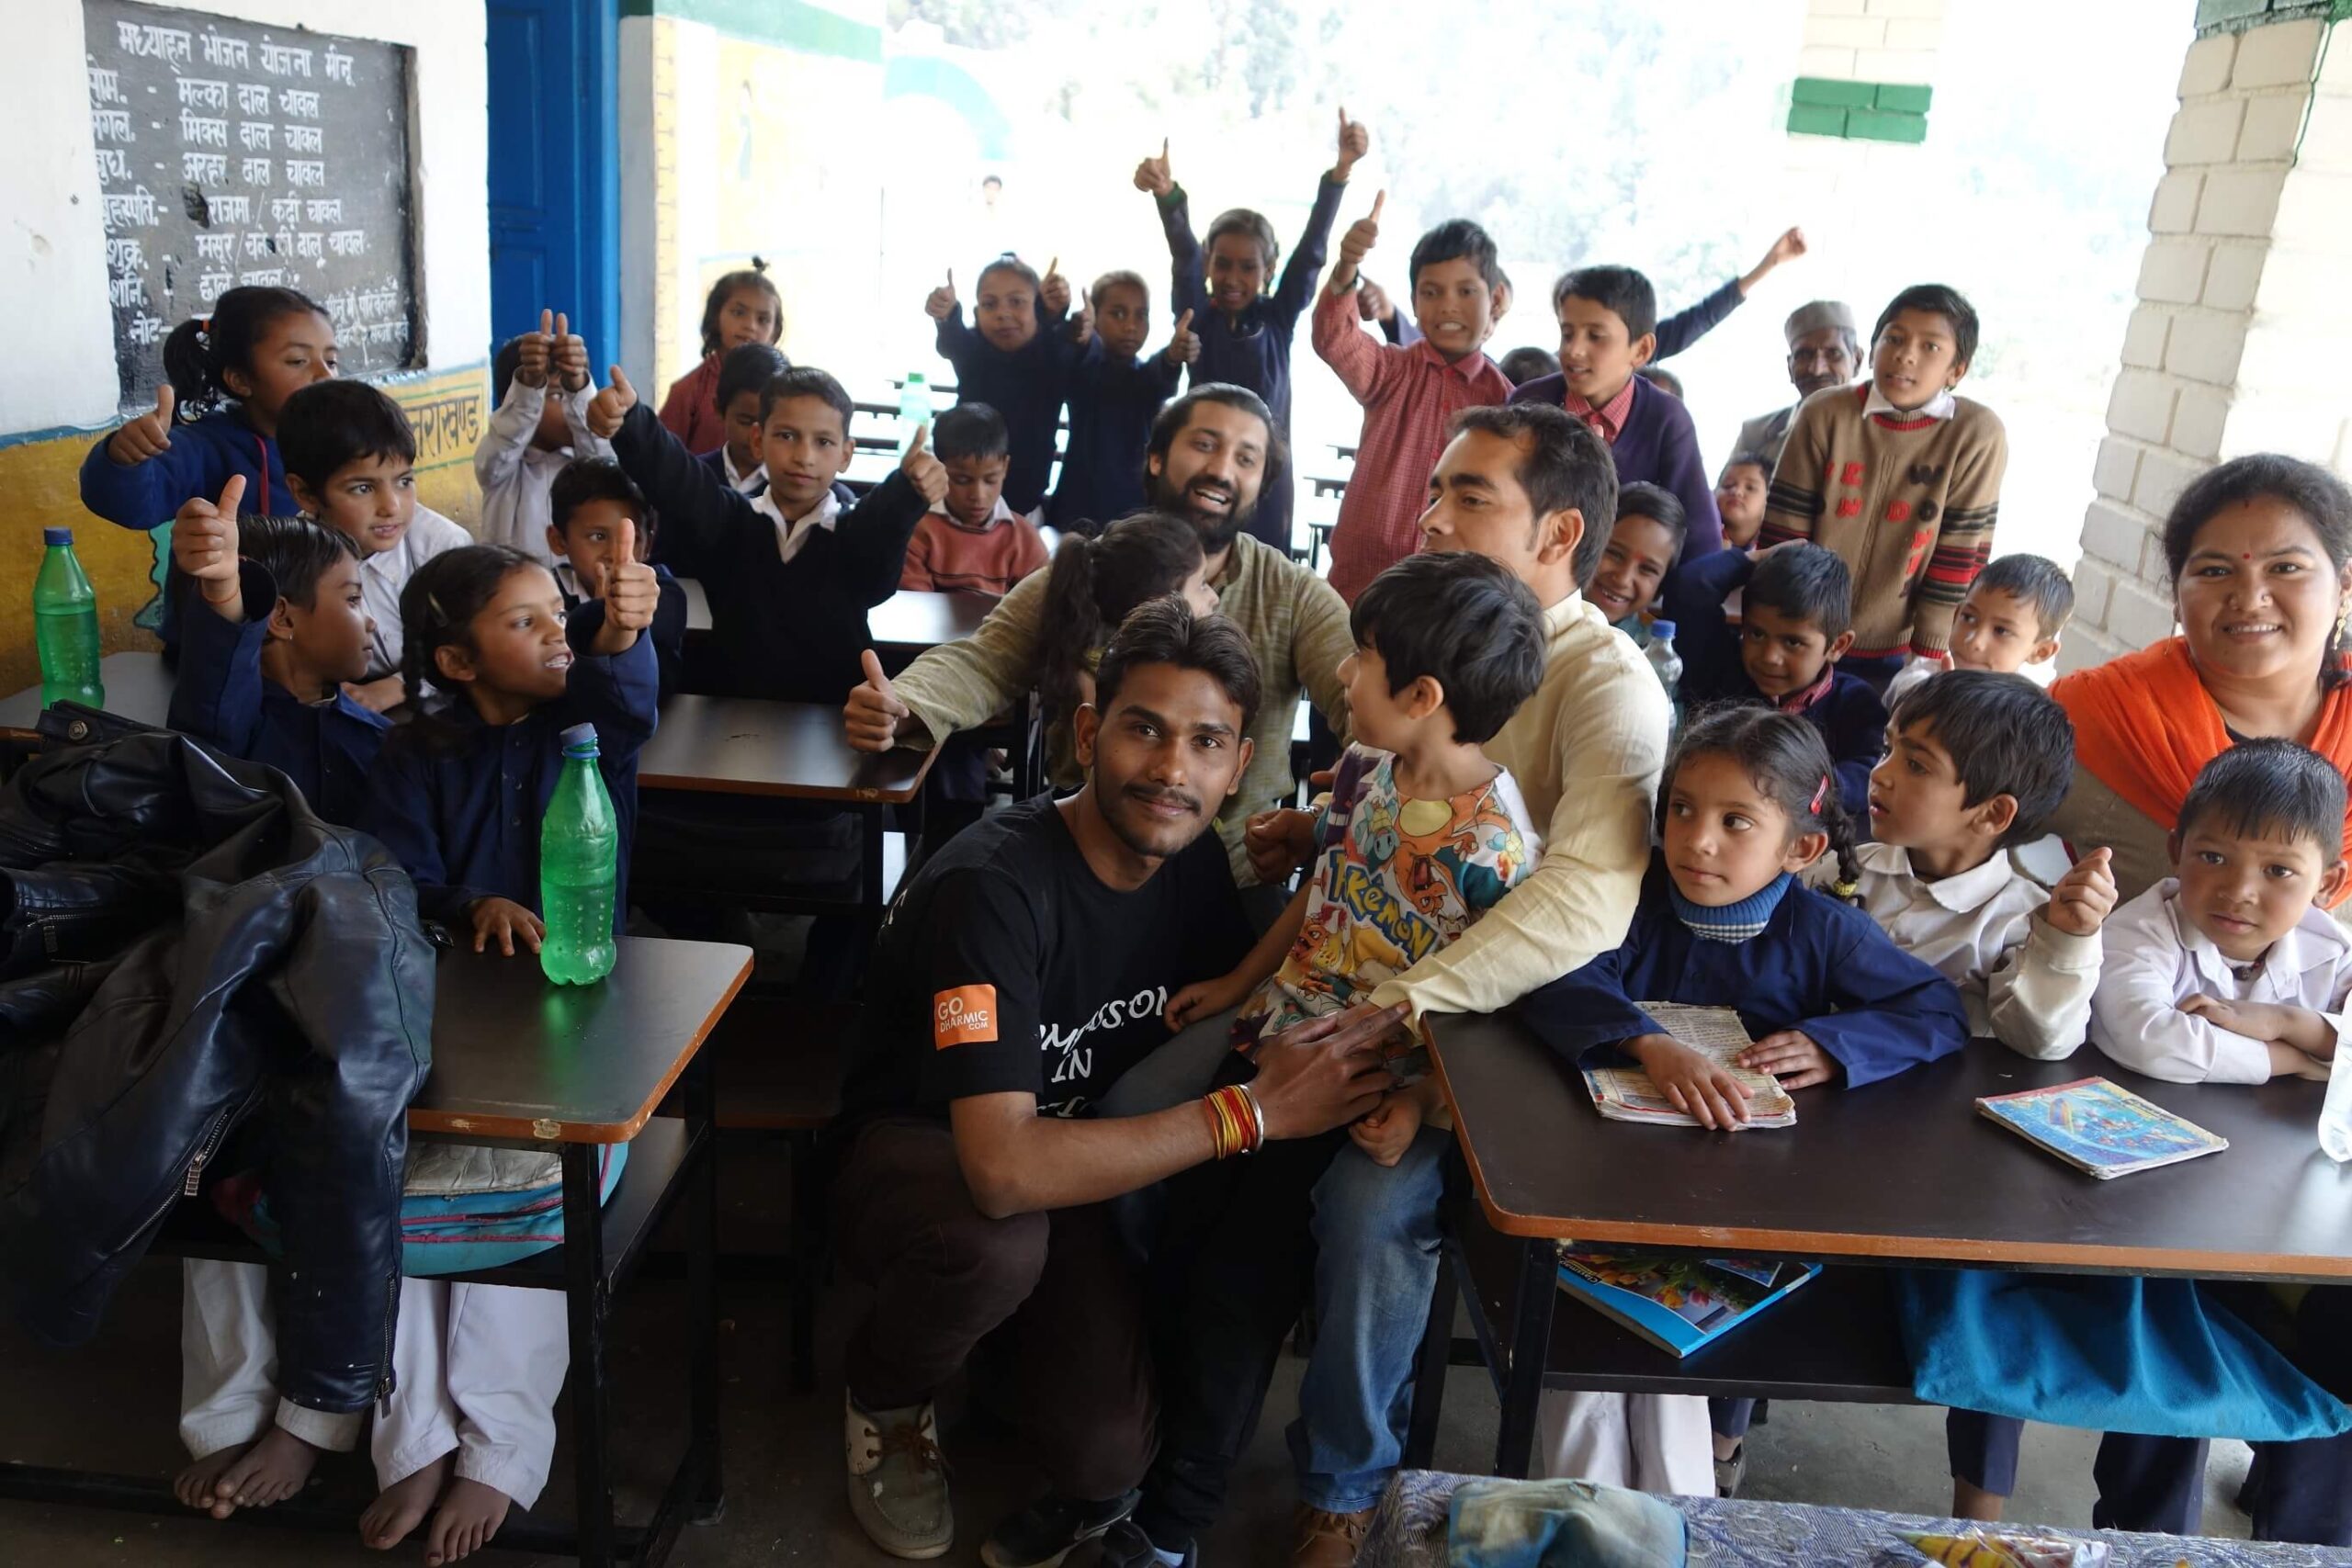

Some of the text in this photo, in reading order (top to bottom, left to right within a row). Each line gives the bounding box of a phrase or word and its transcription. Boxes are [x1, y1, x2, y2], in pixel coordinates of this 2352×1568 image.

[199, 24, 250, 70] भोजन
[259, 34, 312, 78] योजना
[237, 83, 271, 117] दाल
[278, 88, 320, 118] चावल
[240, 121, 275, 152] दाल
[284, 124, 323, 154] चावल
[242, 157, 271, 185] दाल
[286, 159, 324, 186] चावल
[207, 196, 250, 226] राजमा
[306, 198, 342, 224] चावल
[297, 232, 324, 258] दाल
[938, 997, 964, 1021] GO
[940, 1010, 989, 1033] DHARMIC
[1051, 1047, 1092, 1083] IN
